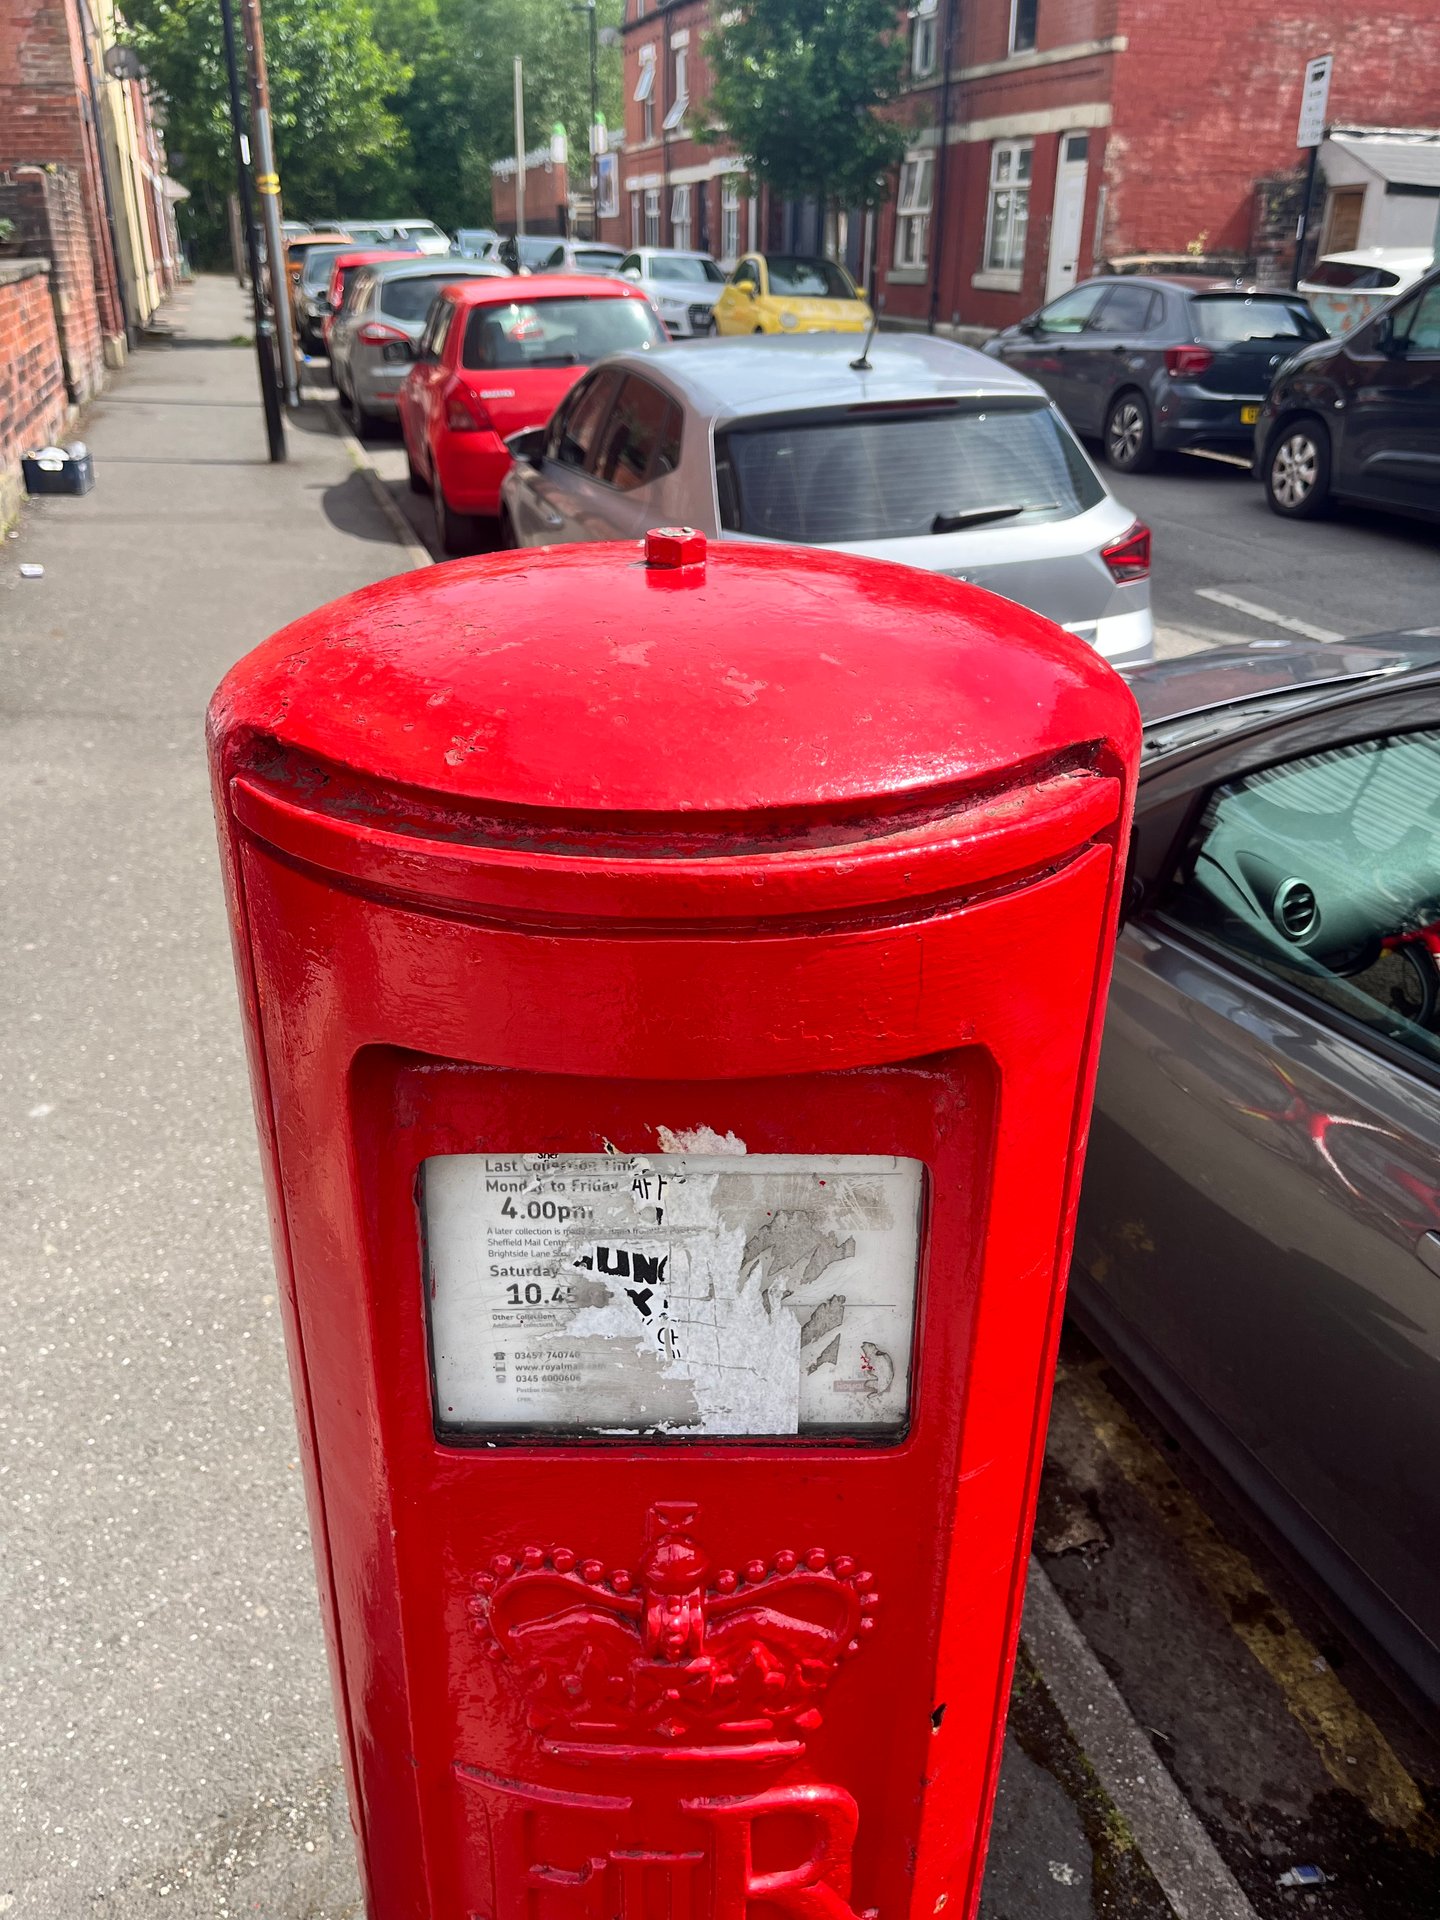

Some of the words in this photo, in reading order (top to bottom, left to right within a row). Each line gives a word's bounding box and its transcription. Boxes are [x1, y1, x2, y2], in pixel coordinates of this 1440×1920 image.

[485, 1159, 518, 1172] Last
[486, 1179, 543, 1195] Mondy
[551, 1180, 566, 1192] to
[572, 1178, 619, 1193] Friday
[501, 1196, 594, 1223] 4.00pm
[487, 1227, 493, 1235] A
[494, 1227, 513, 1235] later
[515, 1227, 552, 1235] collection
[554, 1227, 561, 1235] is
[488, 1238, 522, 1247] Sheffield
[524, 1238, 541, 1246] Mail
[488, 1249, 529, 1259] Brightside
[490, 1264, 559, 1278] Saturday
[506, 1282, 576, 1305] 10.4
[516, 1312, 556, 1321] Collections
[515, 1374, 539, 1383] 0345
